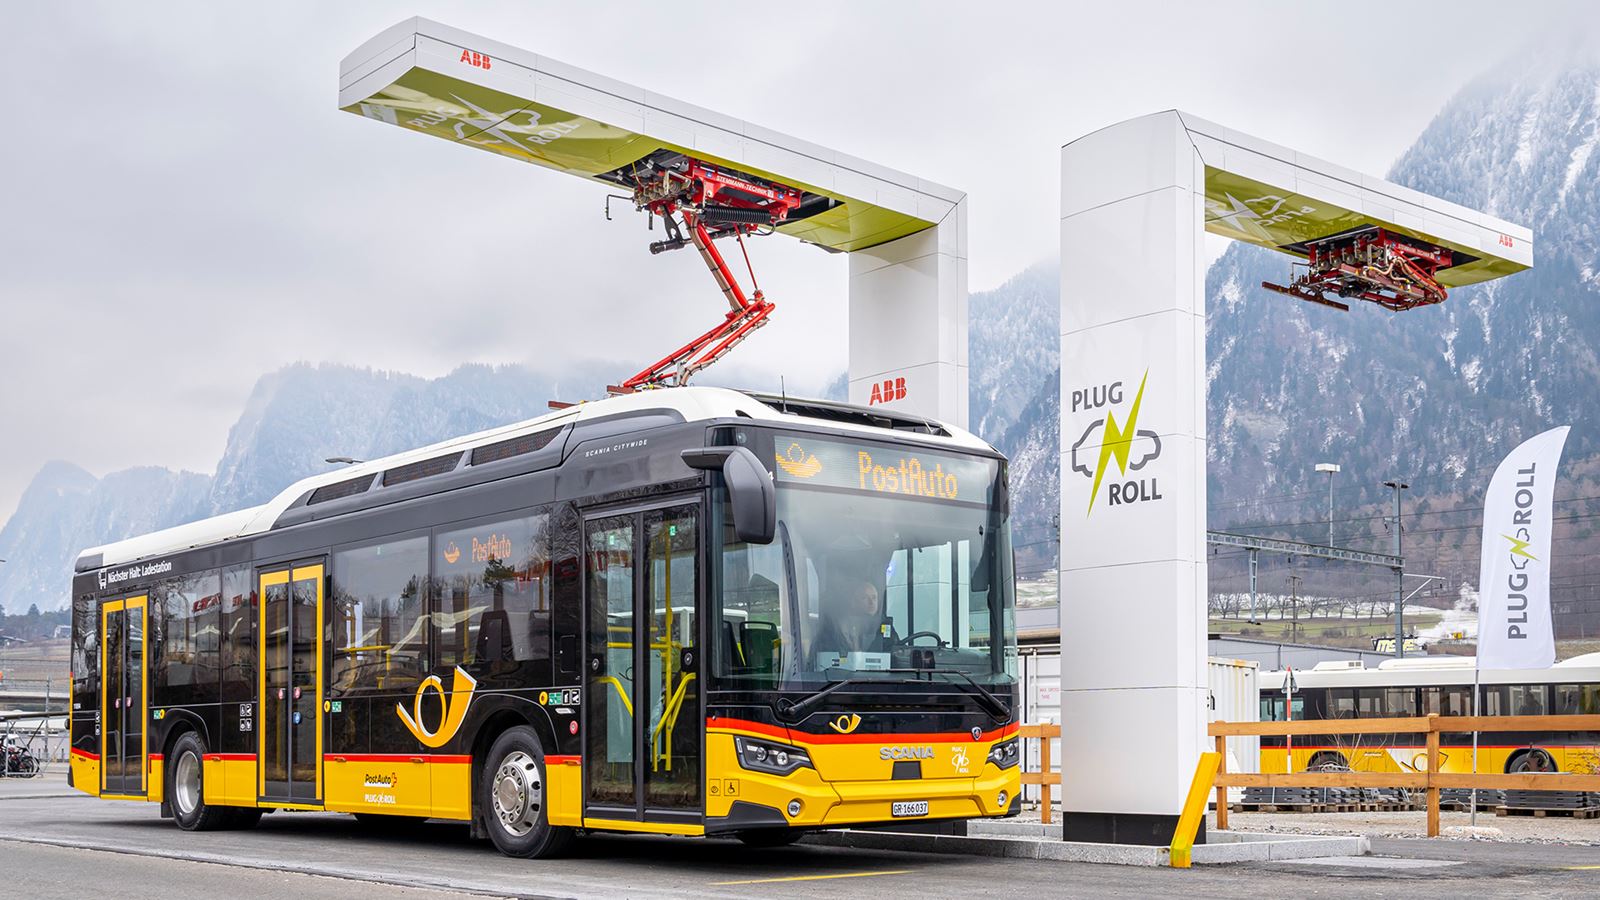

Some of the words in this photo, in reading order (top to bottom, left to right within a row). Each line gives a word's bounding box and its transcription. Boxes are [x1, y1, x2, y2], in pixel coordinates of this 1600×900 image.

[460, 49, 491, 70] ABB
[408, 106, 457, 129] PLUG
[526, 121, 581, 145] ROLL
[1498, 235, 1513, 248] ABB
[869, 377, 907, 406] ABB
[1072, 381, 1123, 413] PLUG
[584, 446, 610, 458] SCANIA
[613, 439, 648, 451] CITYWIDE
[858, 451, 958, 499] PostAuto
[1109, 478, 1162, 506] ROLL
[1513, 462, 1536, 525] ROLL
[141, 560, 172, 577] Ladestation
[1507, 573, 1528, 640] PLUG
[880, 746, 935, 760] SCANIA
[365, 773, 392, 784] PostAuto
